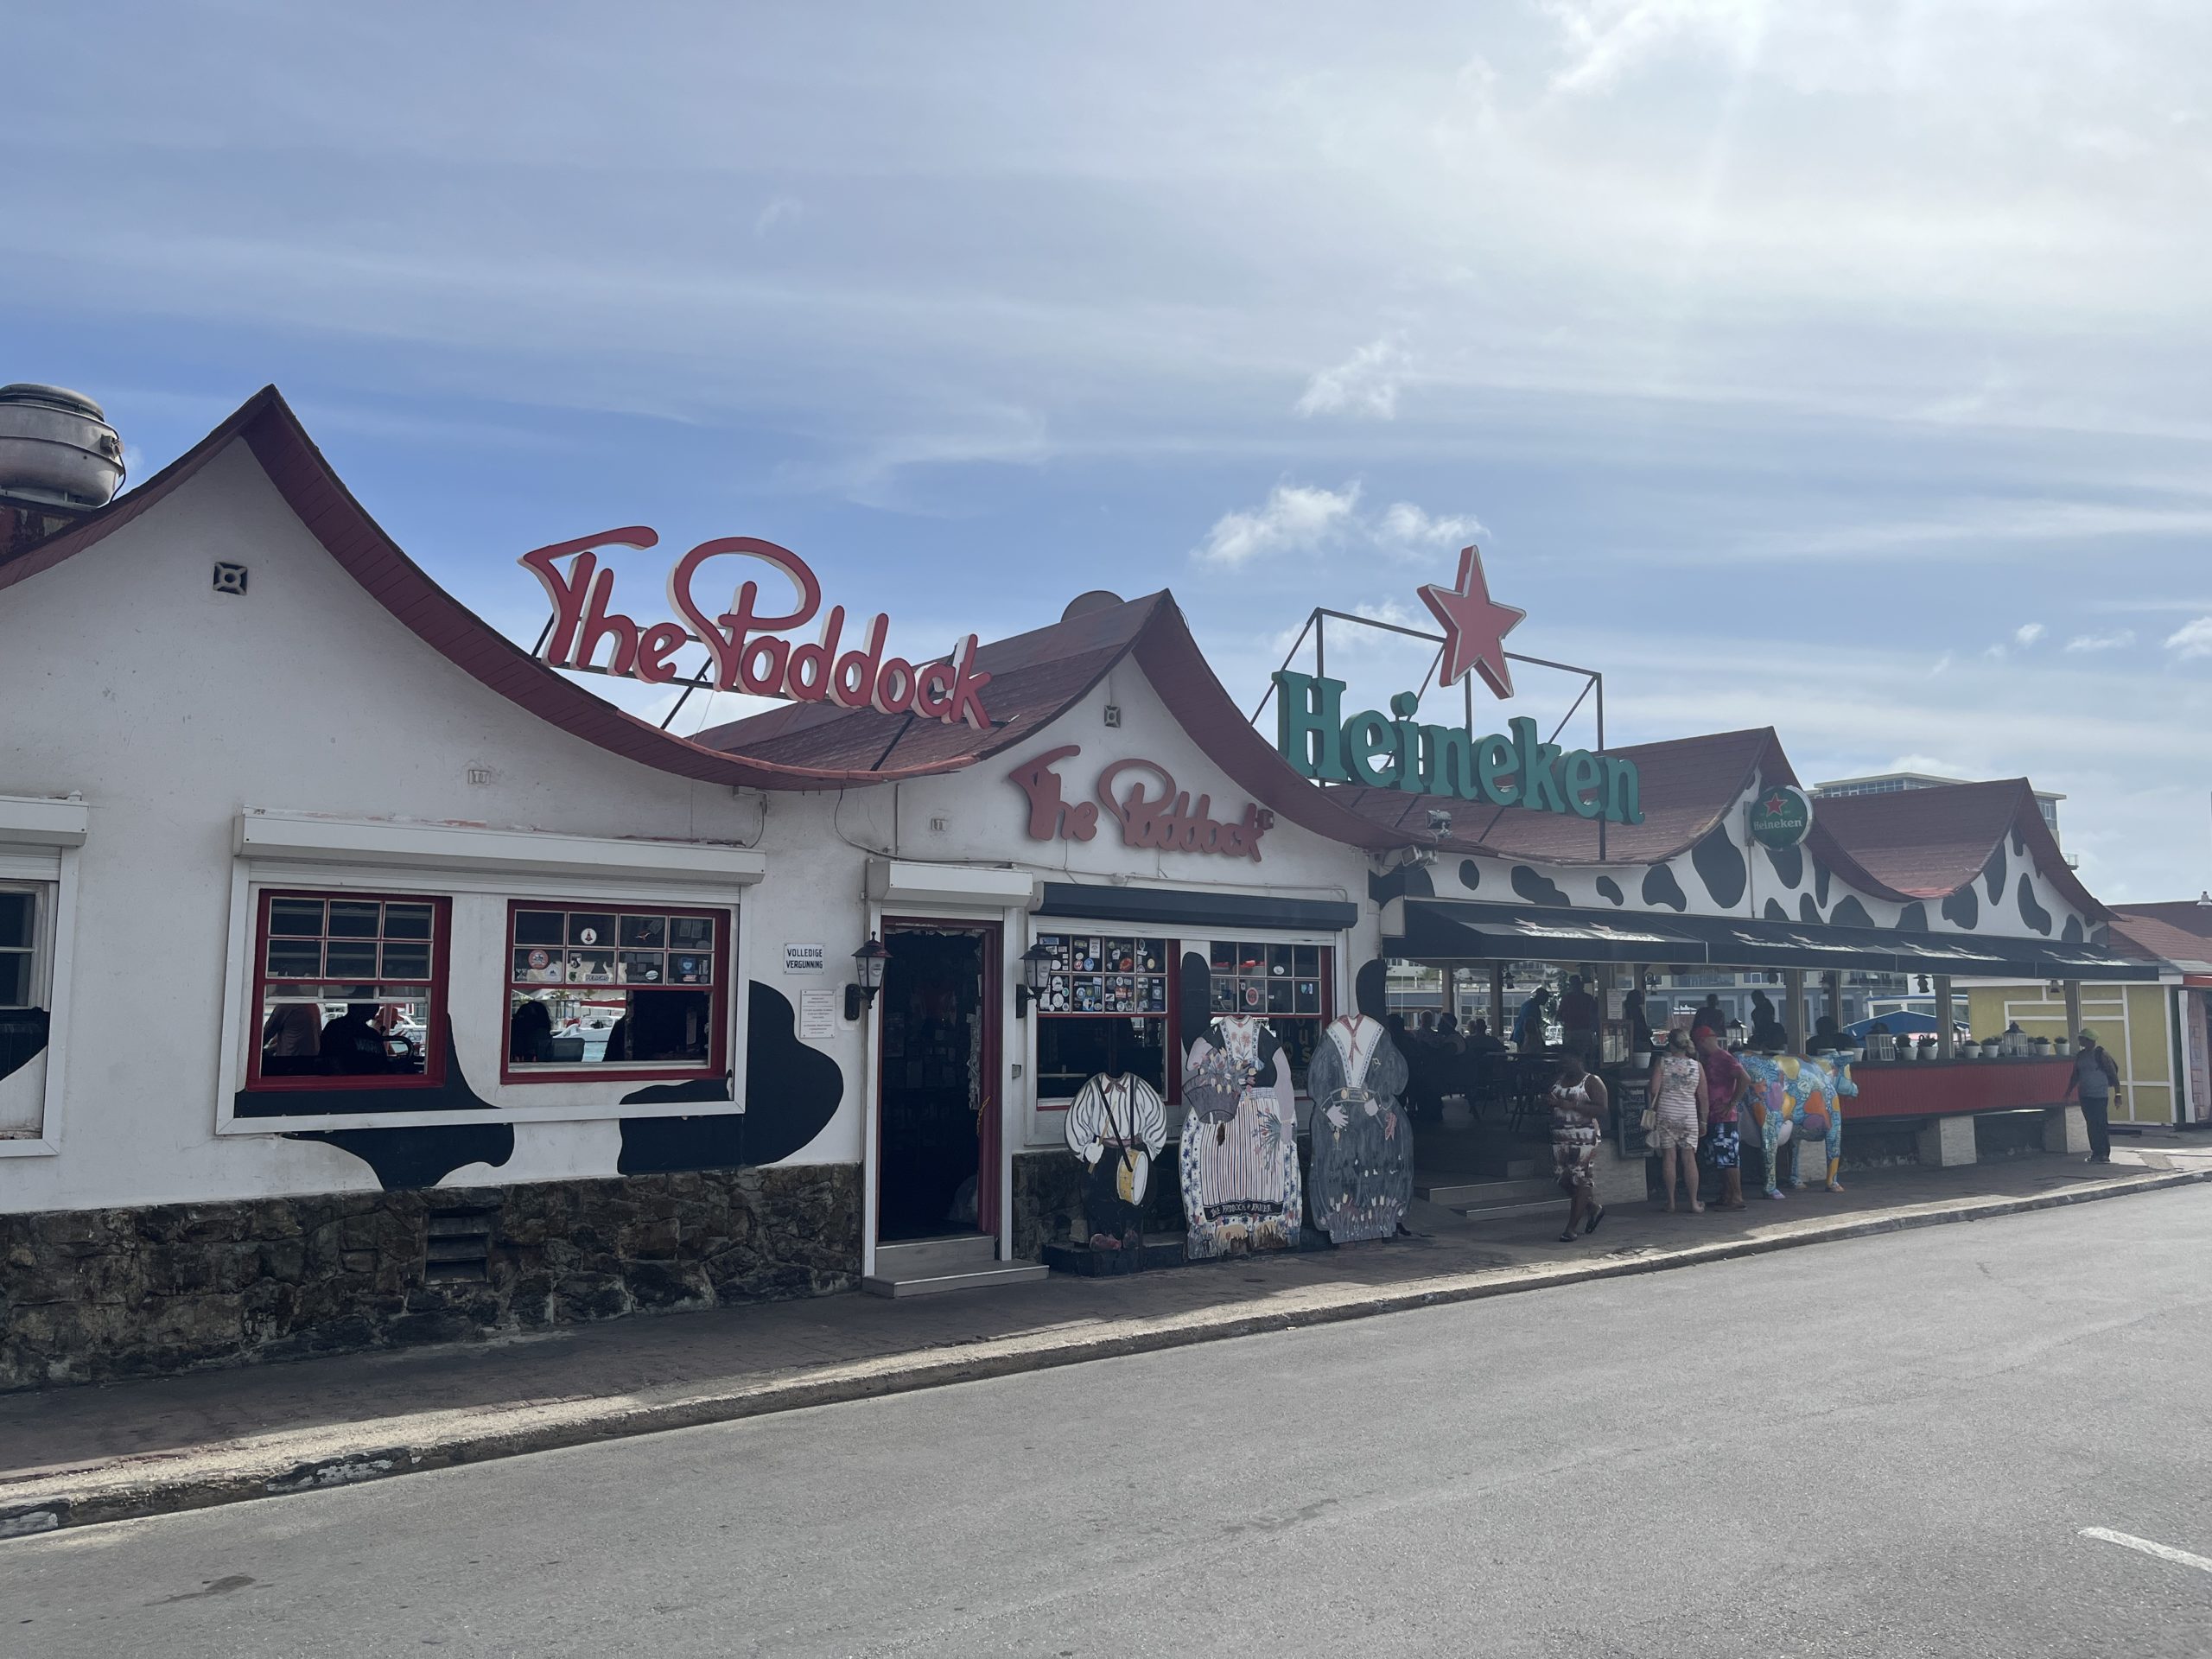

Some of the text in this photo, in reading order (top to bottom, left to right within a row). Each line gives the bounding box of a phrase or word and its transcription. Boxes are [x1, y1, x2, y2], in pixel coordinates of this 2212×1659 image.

[518, 525, 991, 730] The Paddock
[1008, 745, 1264, 863] The Paddock
[1271, 671, 1646, 826] Heineken
[1753, 819, 1802, 830] Heineken
[787, 949, 823, 957] VOLLEDIGE
